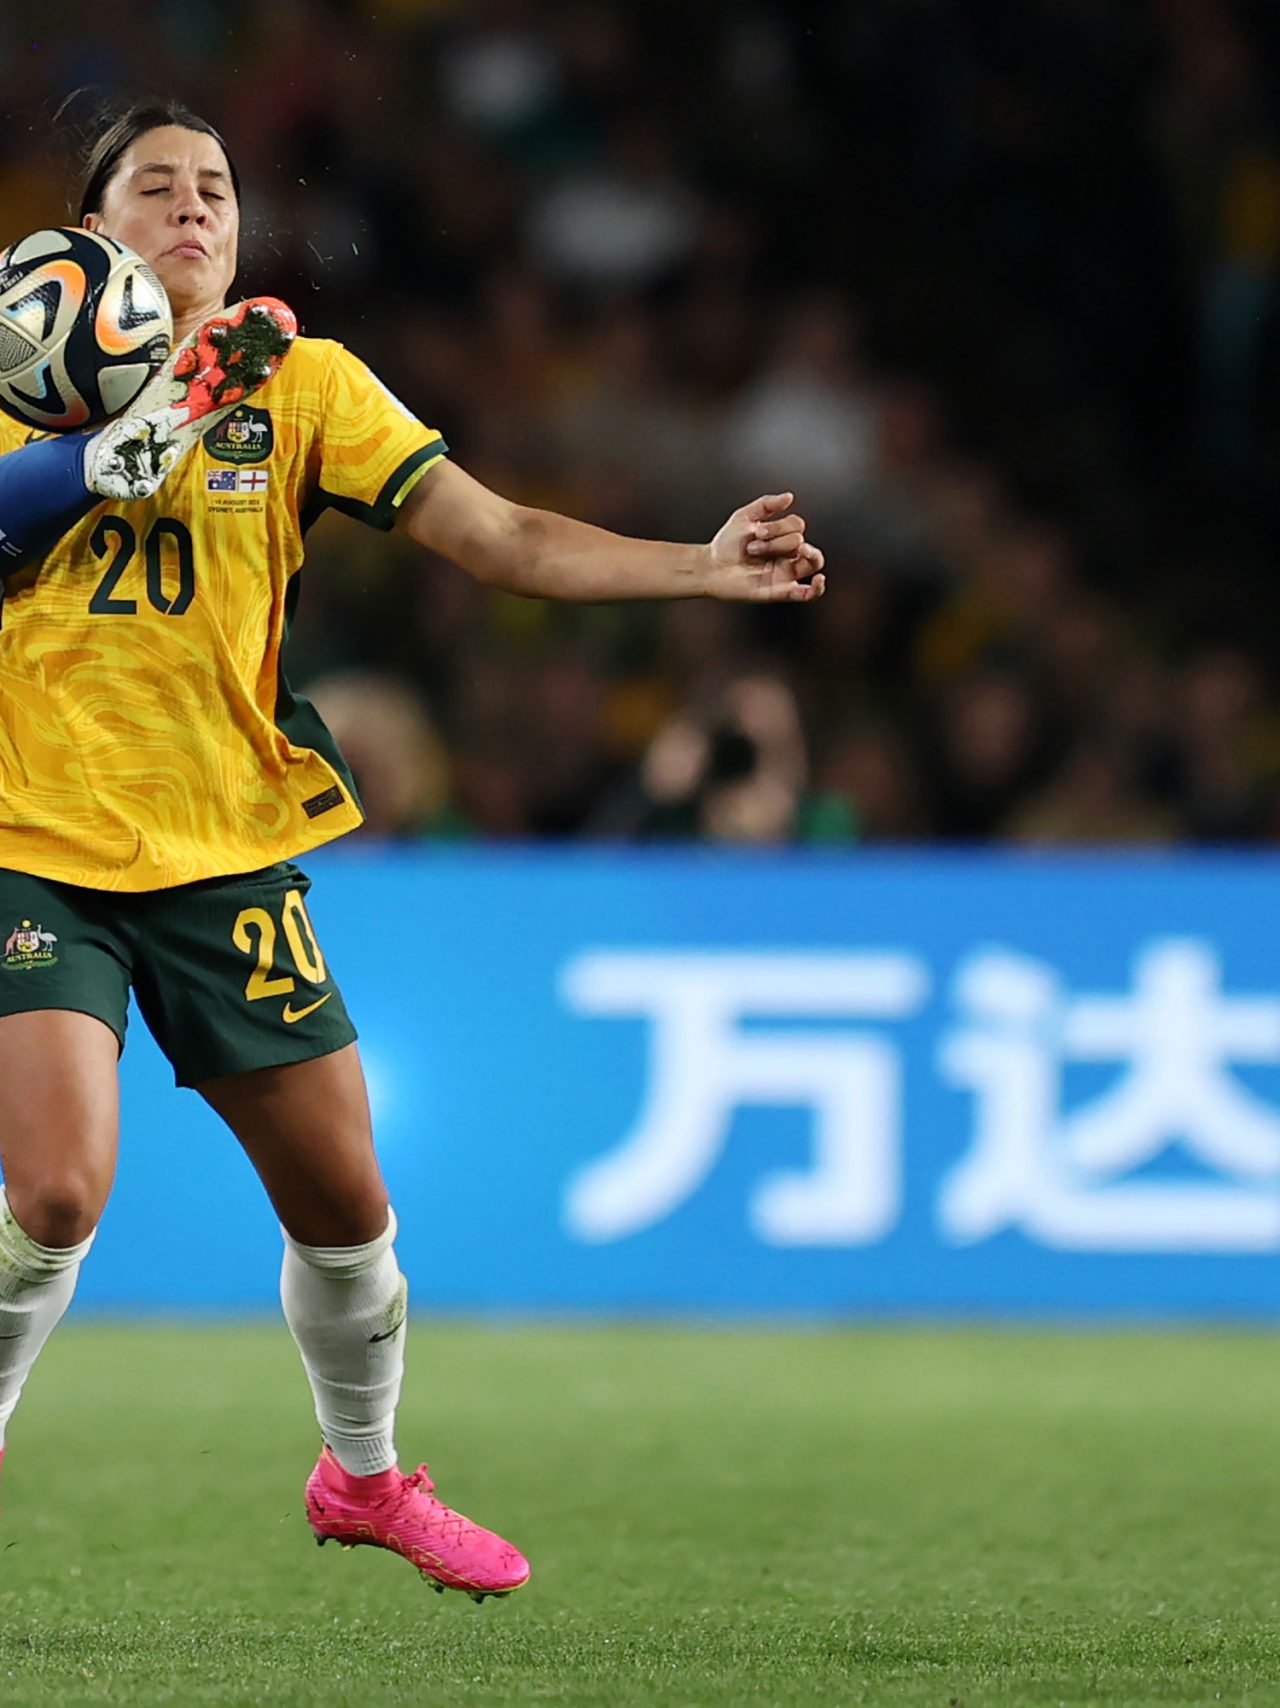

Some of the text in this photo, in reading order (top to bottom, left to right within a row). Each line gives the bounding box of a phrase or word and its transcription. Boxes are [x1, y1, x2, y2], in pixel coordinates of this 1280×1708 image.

[215, 442, 261, 450] AUSTRALIA
[88, 515, 196, 616] 20
[6, 951, 53, 963] AUSTRALIA
[232, 890, 327, 1001] 20
[558, 936, 1280, 1254] 万达
